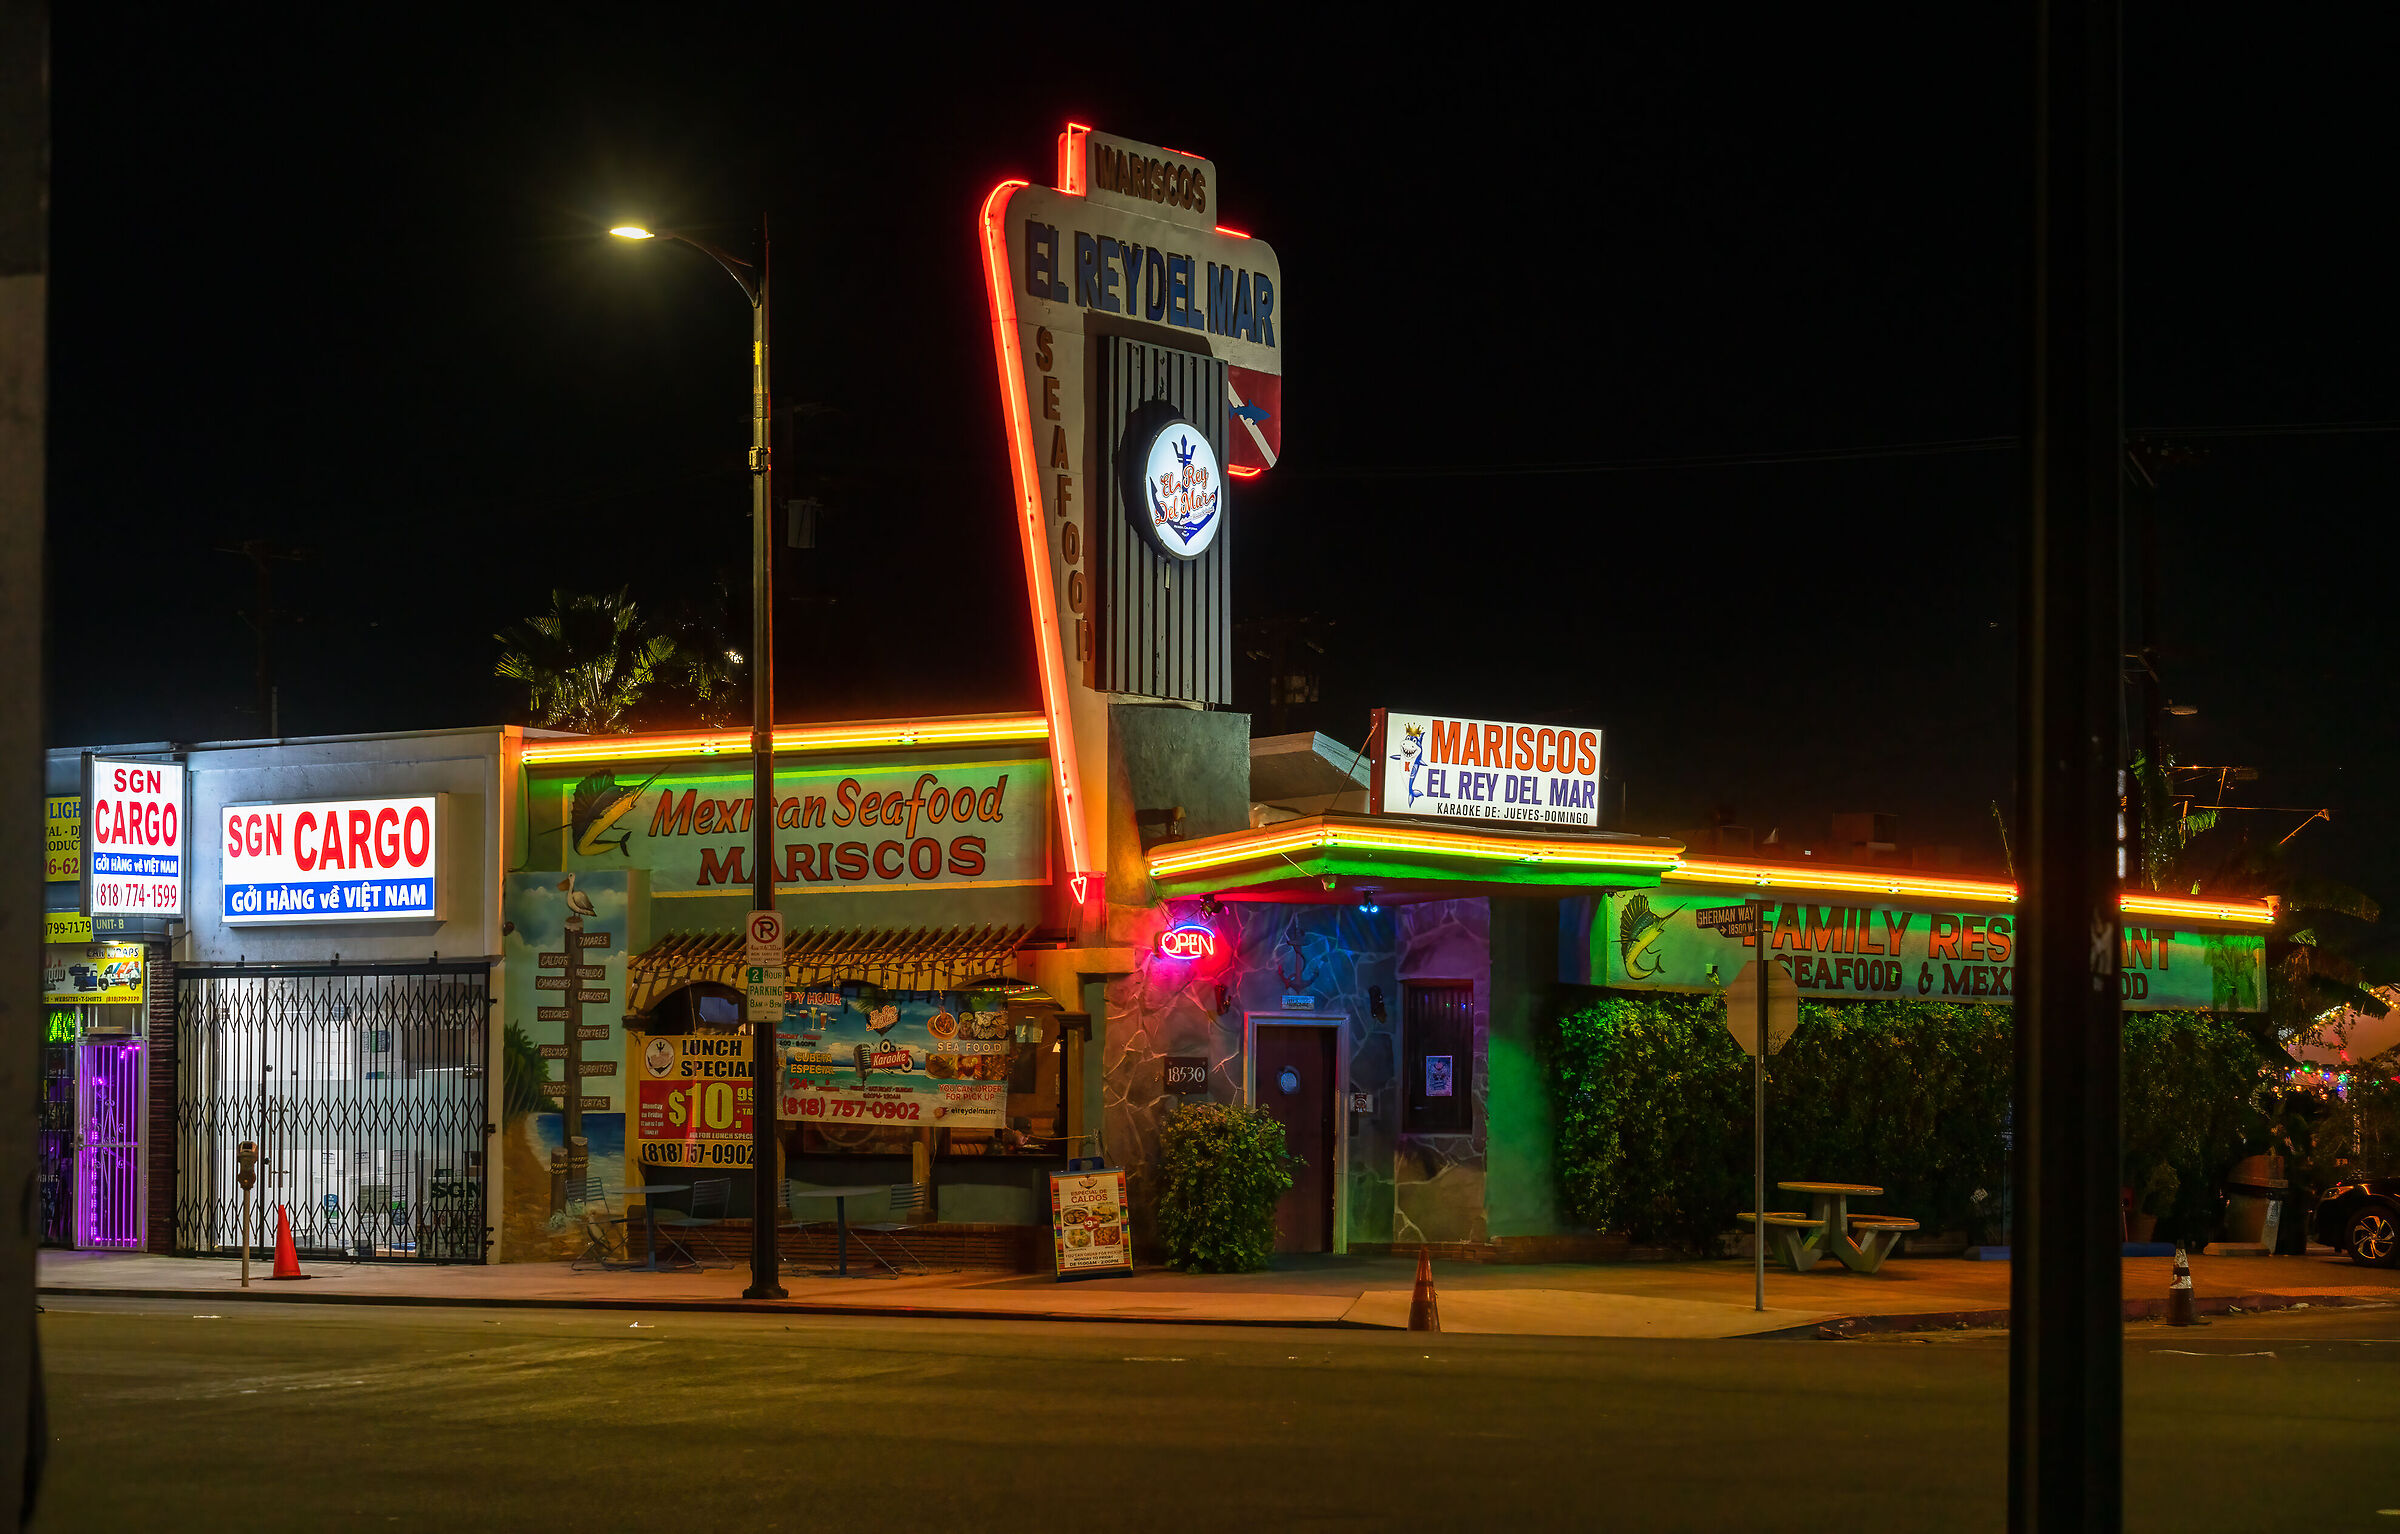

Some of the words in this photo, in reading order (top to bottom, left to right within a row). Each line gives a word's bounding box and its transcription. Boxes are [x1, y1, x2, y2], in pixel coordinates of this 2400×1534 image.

[1094, 142, 1206, 214] MARISCOS
[1025, 219, 1069, 304] EL
[1074, 230, 1144, 316] REY
[1145, 245, 1205, 331] DEL
[1207, 261, 1276, 348] MAR
[1160, 472, 1181, 497] El
[1183, 464, 1209, 489] Rey
[1035, 325, 1092, 662] SEAFOOD
[1155, 496, 1178, 526] Del
[1180, 488, 1215, 515] Mar
[1430, 719, 1597, 776] MARISCOS
[114, 769, 161, 794] SGN
[1426, 768, 1451, 798] EL
[1458, 771, 1499, 802] REY
[1505, 774, 1543, 805] DEL
[1549, 778, 1596, 809] MAR
[50, 801, 80, 819] LIGH
[648, 788, 826, 837] Mexian
[832, 773, 1009, 840] Seafood
[1437, 803, 1481, 817] KARAOKE
[1485, 806, 1501, 818] DE:
[1504, 807, 1588, 824] JUEVES-DOMINGO
[96, 800, 177, 846] CARGO
[46, 840, 80, 851] ODUC
[228, 813, 282, 858] SGN
[294, 806, 430, 872] CARGO
[161, 860, 177, 874] NAM
[96, 883, 122, 906] (818)
[126, 883, 177, 908] 774-1599
[231, 885, 261, 912] GỞI
[266, 885, 314, 911] HÀNG
[319, 885, 340, 910] về
[343, 882, 381, 911] VIỆT
[385, 884, 426, 906] NAM
[119, 919, 124, 929] B
[1697, 908, 1735, 925] SHERMAN
[1738, 906, 1755, 922] WAY
[1162, 932, 1214, 955] OPEN
[541, 956, 569, 966] CALDOS
[750, 985, 783, 996] PARKING
[784, 992, 806, 1005] PPY
[807, 992, 842, 1005] HOUR
[682, 1039, 742, 1056] LUNCH
[937, 1043, 960, 1052] SEA
[966, 1043, 1002, 1052] FOOD
[578, 1064, 613, 1074] BURRITOS
[791, 1064, 835, 1074] ESPECIAL
[873, 1053, 907, 1066] Karaoke
[1168, 1066, 1206, 1083] 18530
[543, 1085, 567, 1095] TACOS
[580, 1098, 607, 1108] TORTAS
[782, 1095, 826, 1118] (818)
[831, 1099, 920, 1120] 757-0902
[642, 1143, 682, 1162] (818)
[685, 1144, 753, 1164] 757-0902
[1071, 1194, 1108, 1204] CALDOS
